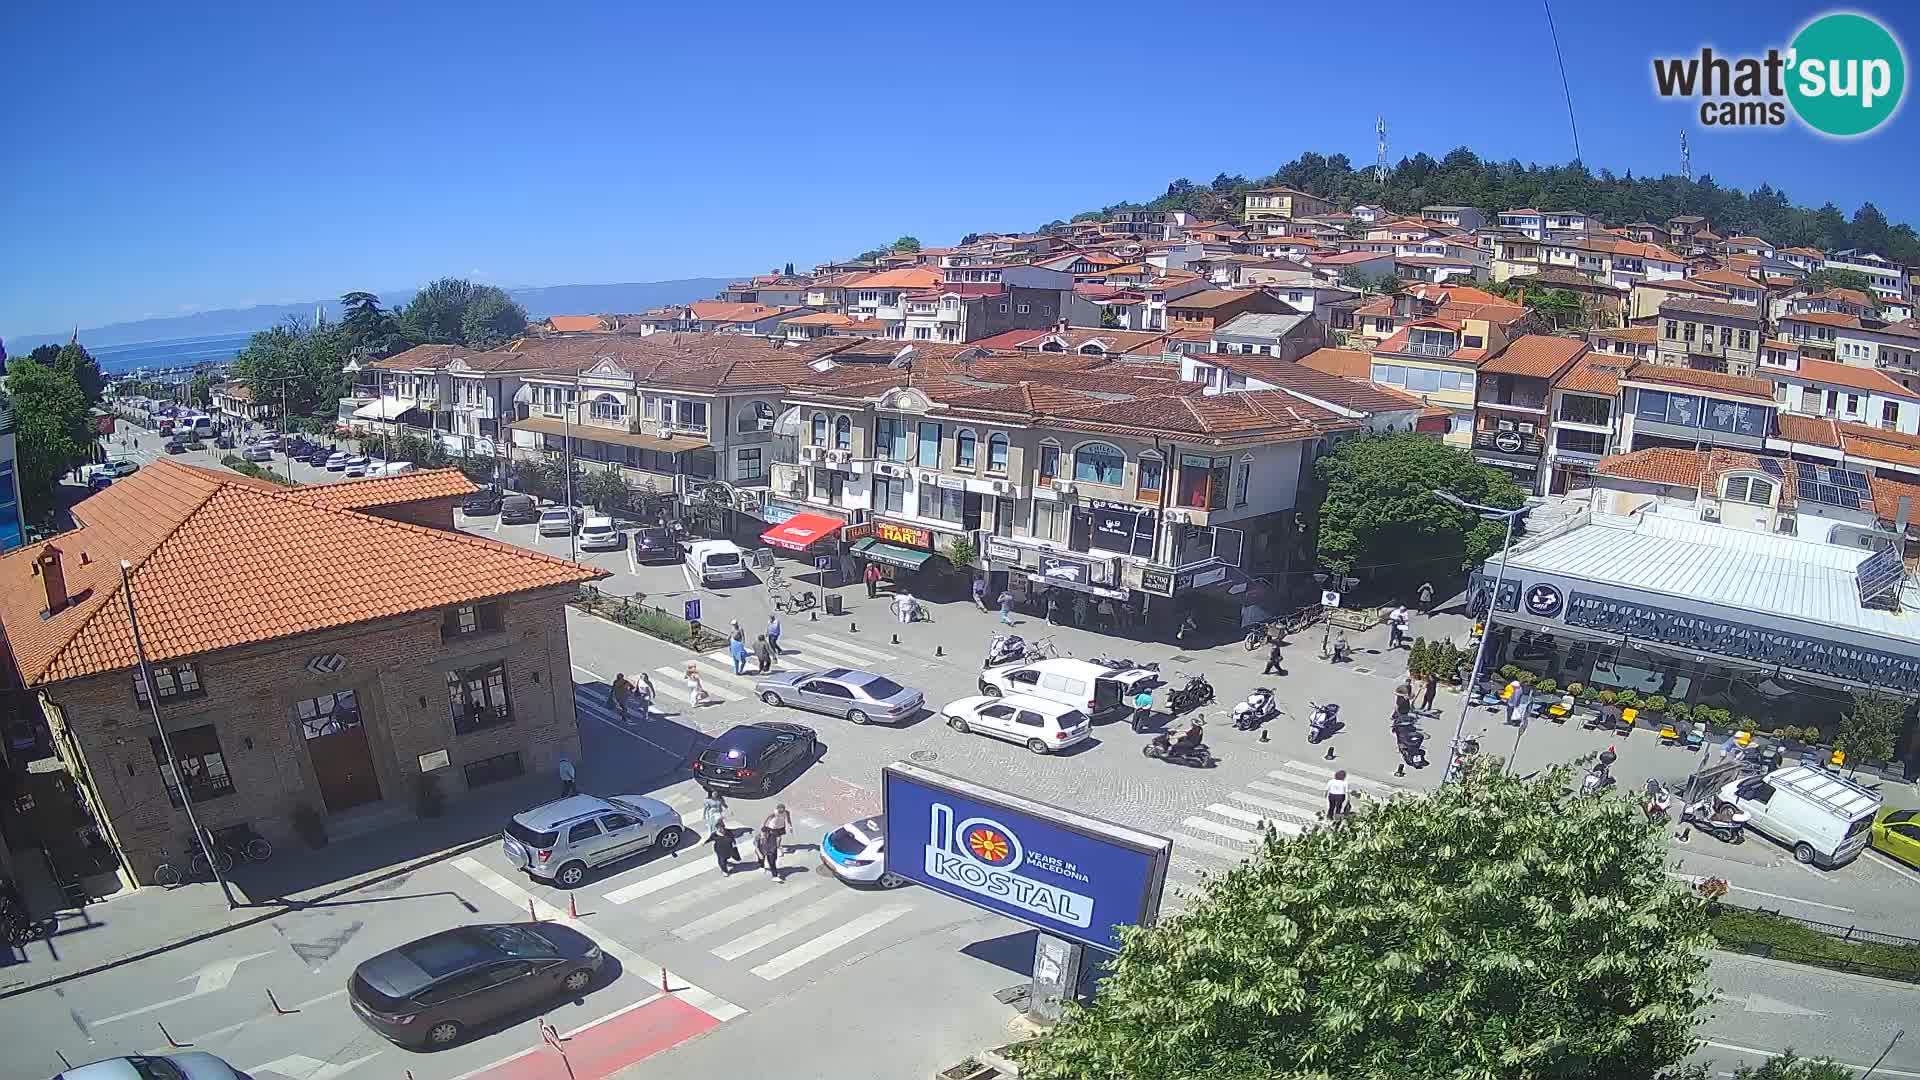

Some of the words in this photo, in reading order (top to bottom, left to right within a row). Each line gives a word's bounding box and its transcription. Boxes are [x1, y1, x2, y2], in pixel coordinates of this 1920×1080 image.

[1026, 857, 1089, 883] MACEDONIA
[1027, 850, 1063, 867] YEARS
[1065, 861, 1078, 872] IN
[934, 853, 1080, 921] KOSTAL
